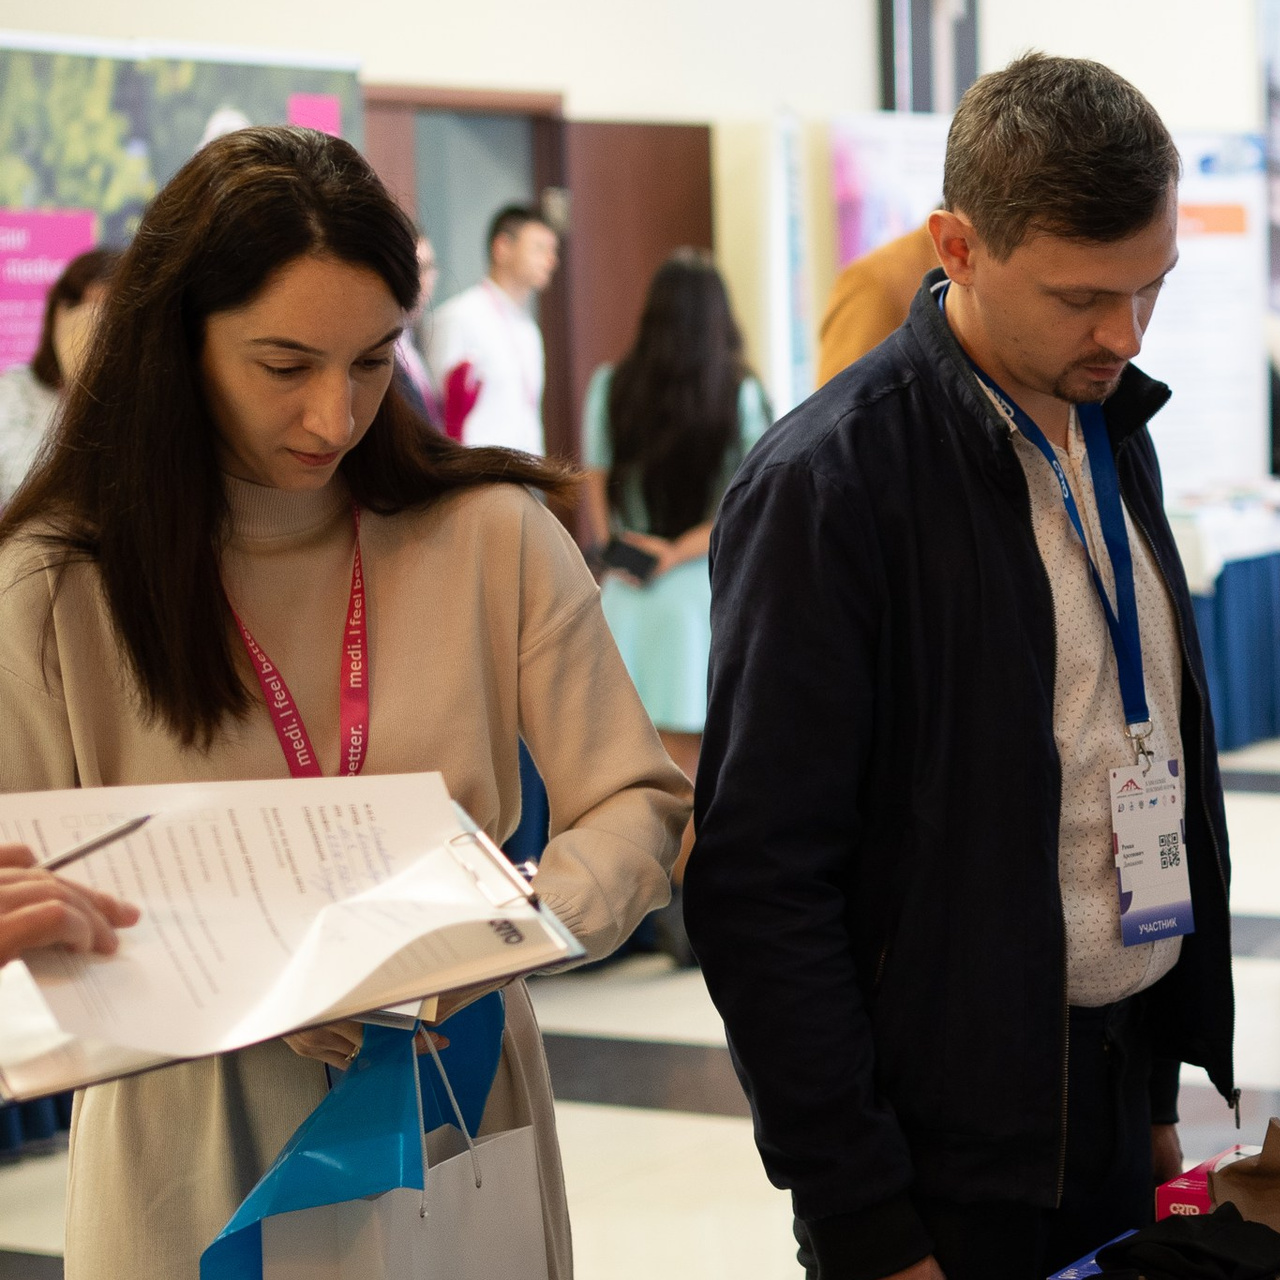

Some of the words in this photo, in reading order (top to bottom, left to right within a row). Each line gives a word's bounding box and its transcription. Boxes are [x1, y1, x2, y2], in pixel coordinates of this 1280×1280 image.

[350, 593, 362, 628] feel
[348, 637, 362, 688] medi.
[265, 676, 289, 711] feel
[283, 718, 311, 767] medi.
[1139, 917, 1177, 935] УЧАСТНИК
[1169, 1203, 1200, 1216] ORTO
